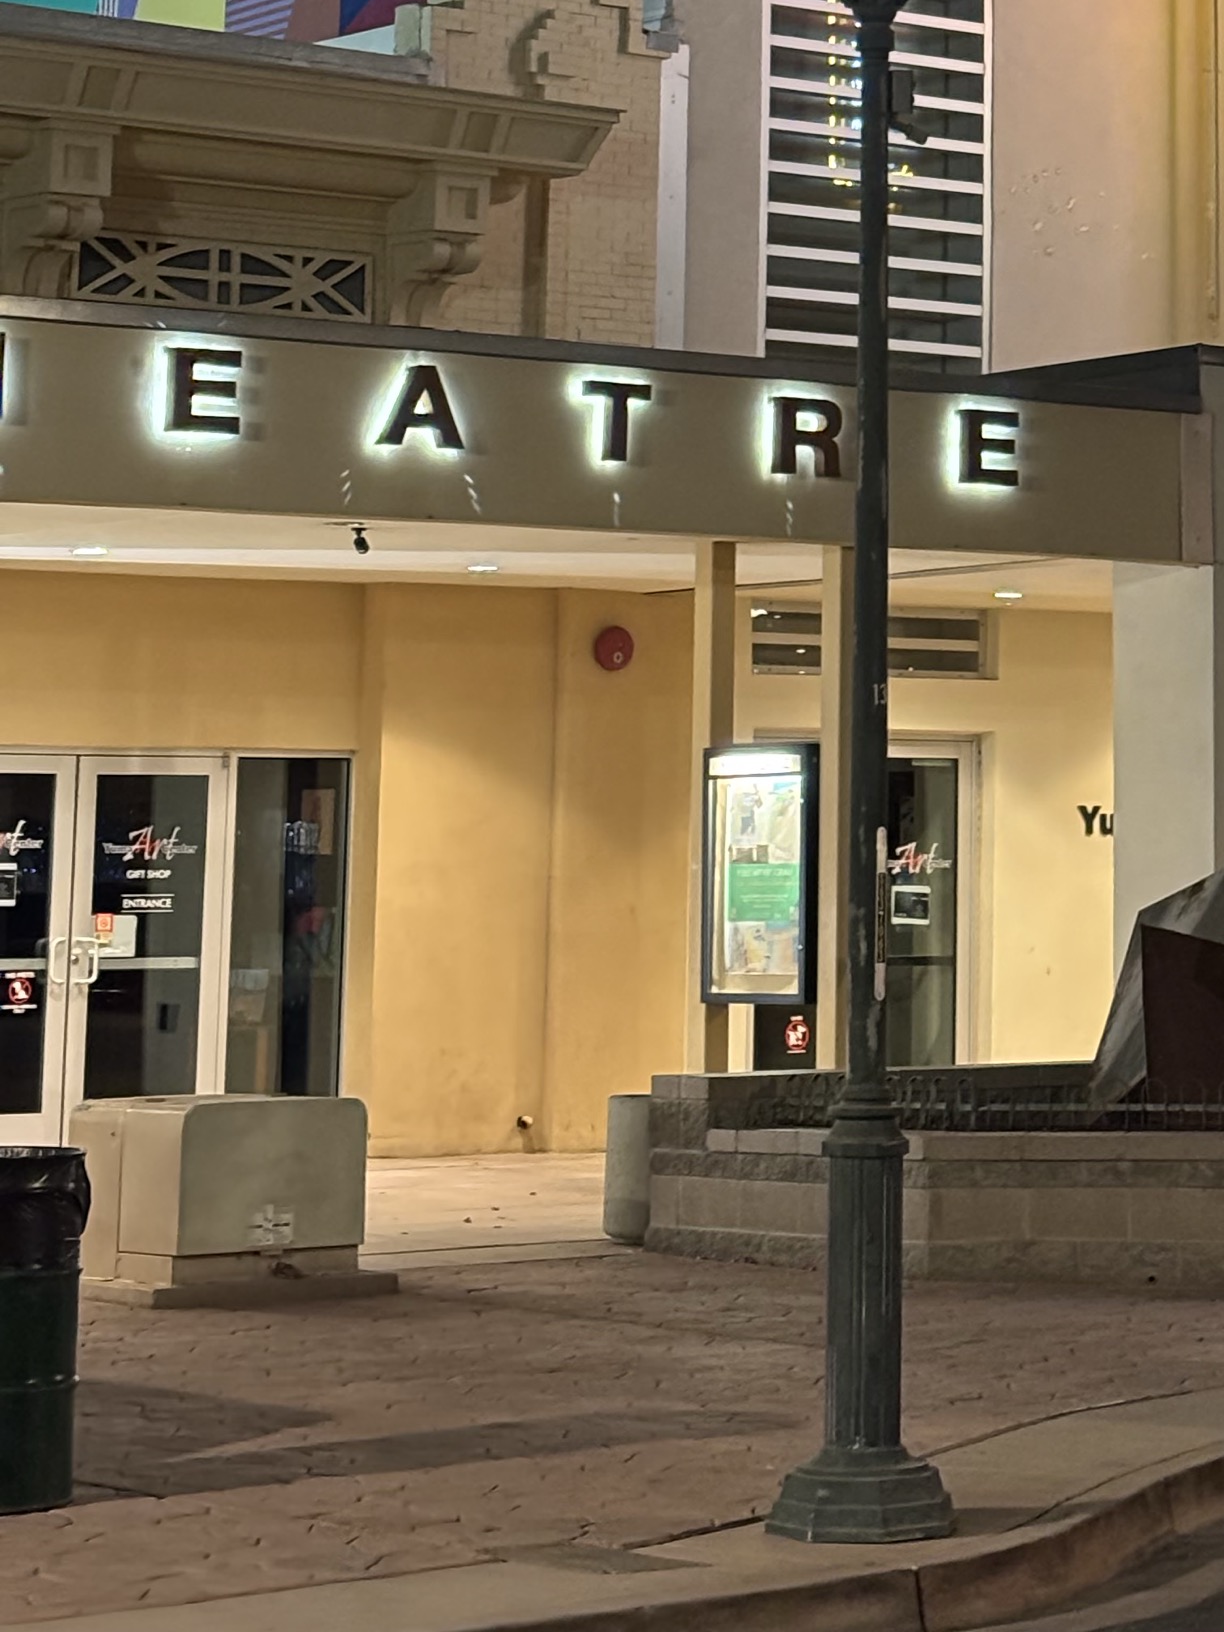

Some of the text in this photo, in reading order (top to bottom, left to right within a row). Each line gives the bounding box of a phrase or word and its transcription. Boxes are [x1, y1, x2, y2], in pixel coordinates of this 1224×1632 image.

[0, 332, 1021, 487] EATRE
[1077, 805, 1114, 837] Yu
[122, 825, 181, 862] Art
[126, 869, 172, 880] GIFT SHOP
[122, 898, 172, 909] ENTRANCE
